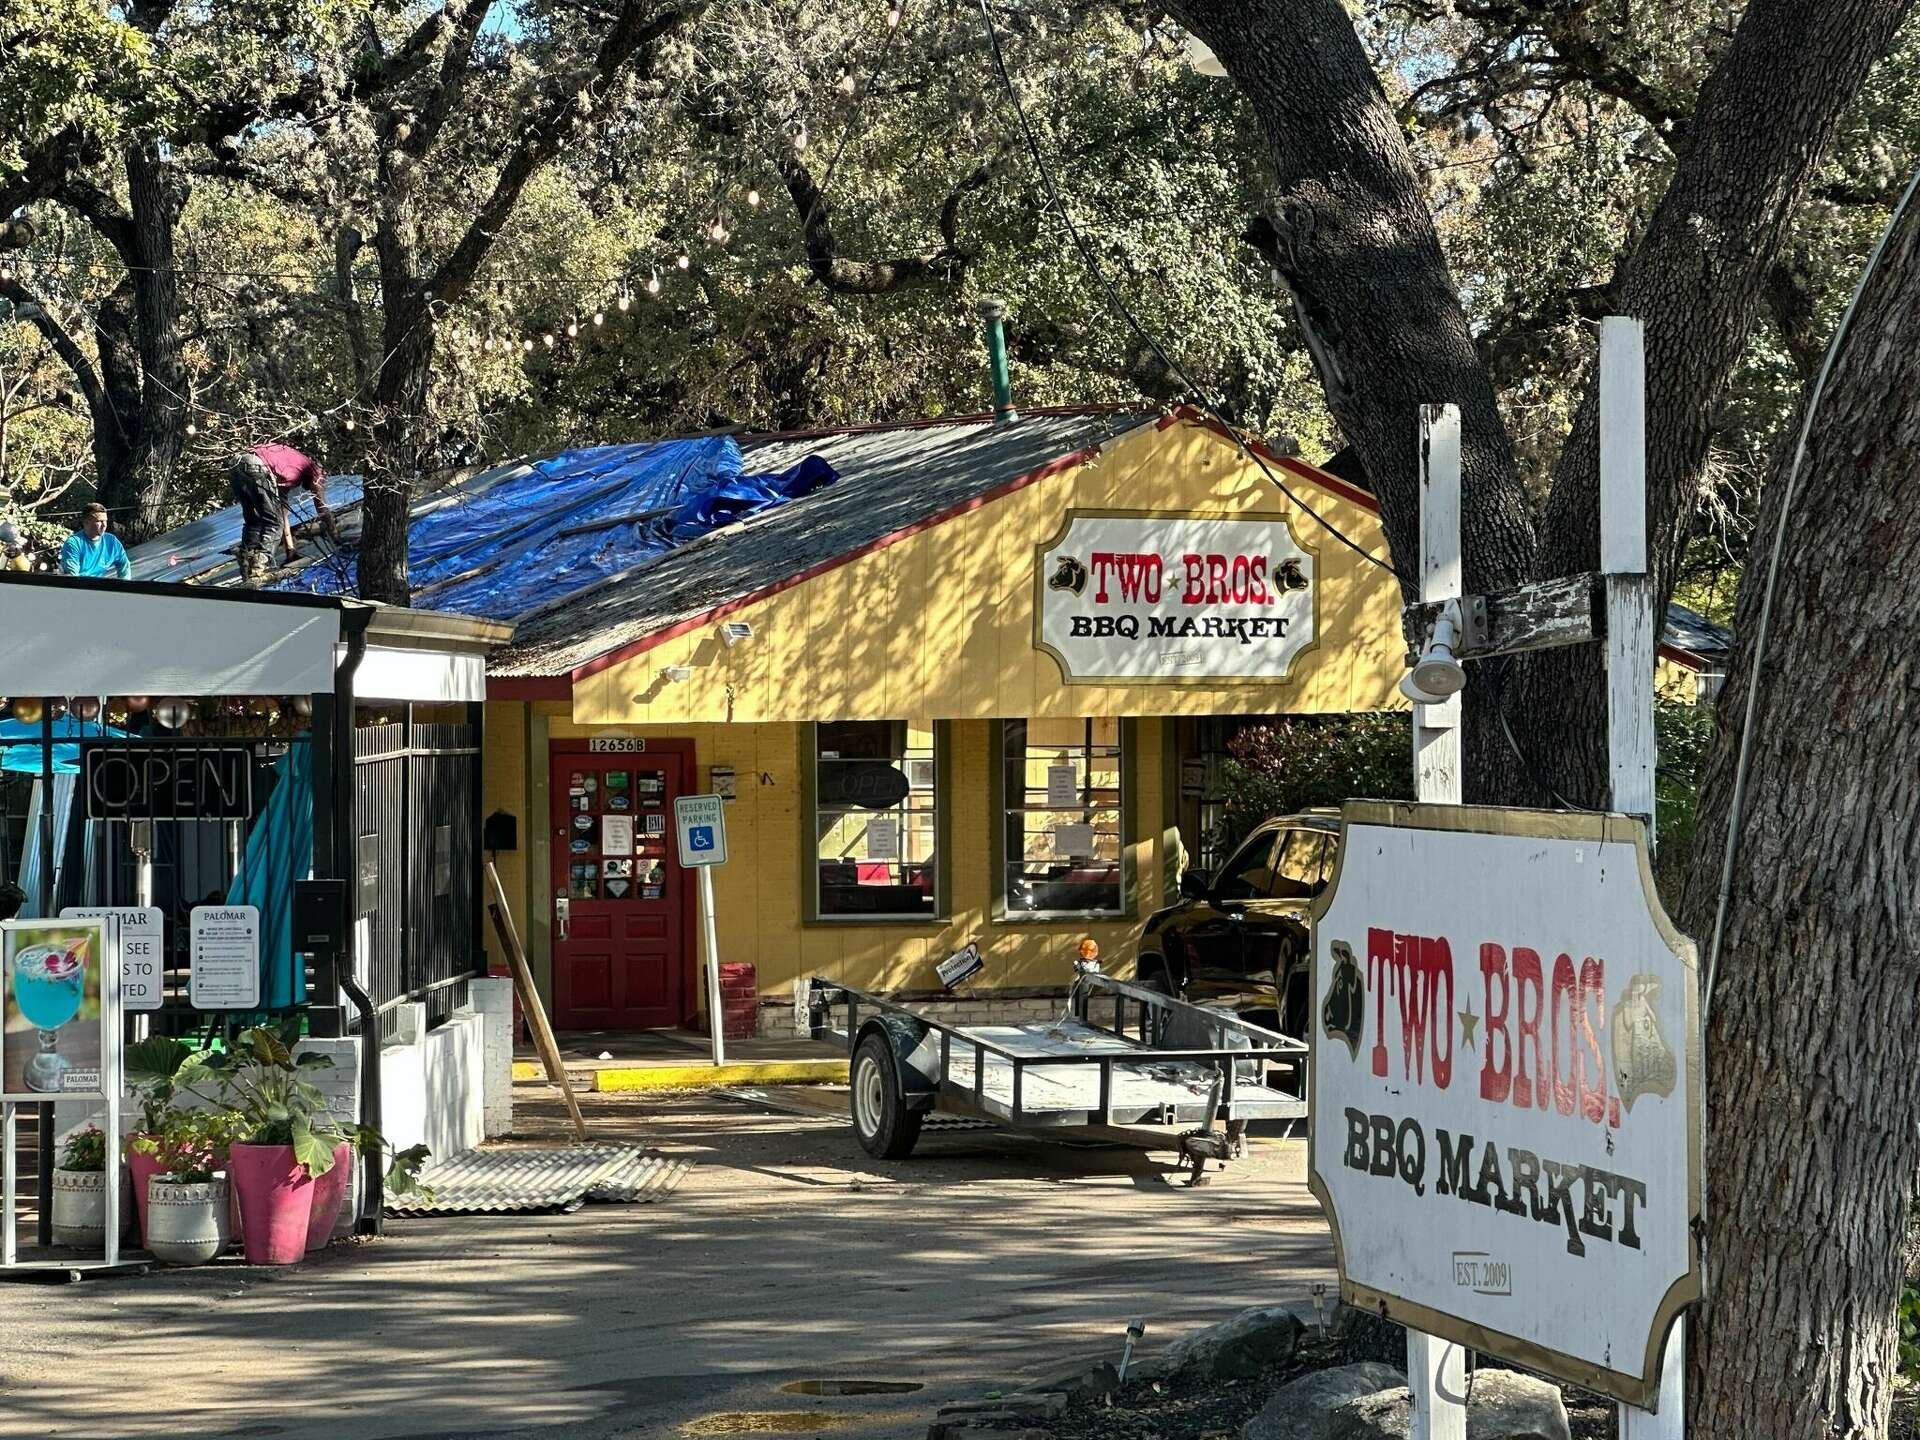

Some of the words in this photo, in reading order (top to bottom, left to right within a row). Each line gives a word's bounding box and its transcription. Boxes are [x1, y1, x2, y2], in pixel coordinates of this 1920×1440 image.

[1091, 552, 1163, 604] TWO
[1182, 553, 1275, 605] BROS.
[1070, 615, 1139, 640] BBQ
[1147, 615, 1290, 644] MARKET
[93, 756, 237, 808] OPEN
[680, 802, 717, 813] RESERVED
[682, 814, 717, 824] PARKING
[204, 912, 246, 920] PALOMAR
[126, 942, 150, 955] SEE
[134, 963, 152, 976] TO
[1366, 927, 1454, 1090] TWO
[1479, 942, 1621, 1129] BROS.
[66, 1075, 98, 1083] PALOMAR
[1343, 1106, 1426, 1197] BBQ
[1435, 1128, 1647, 1258] MARKET
[1456, 1262, 1482, 1286] EST.
[1483, 1262, 1507, 1287] 2009
